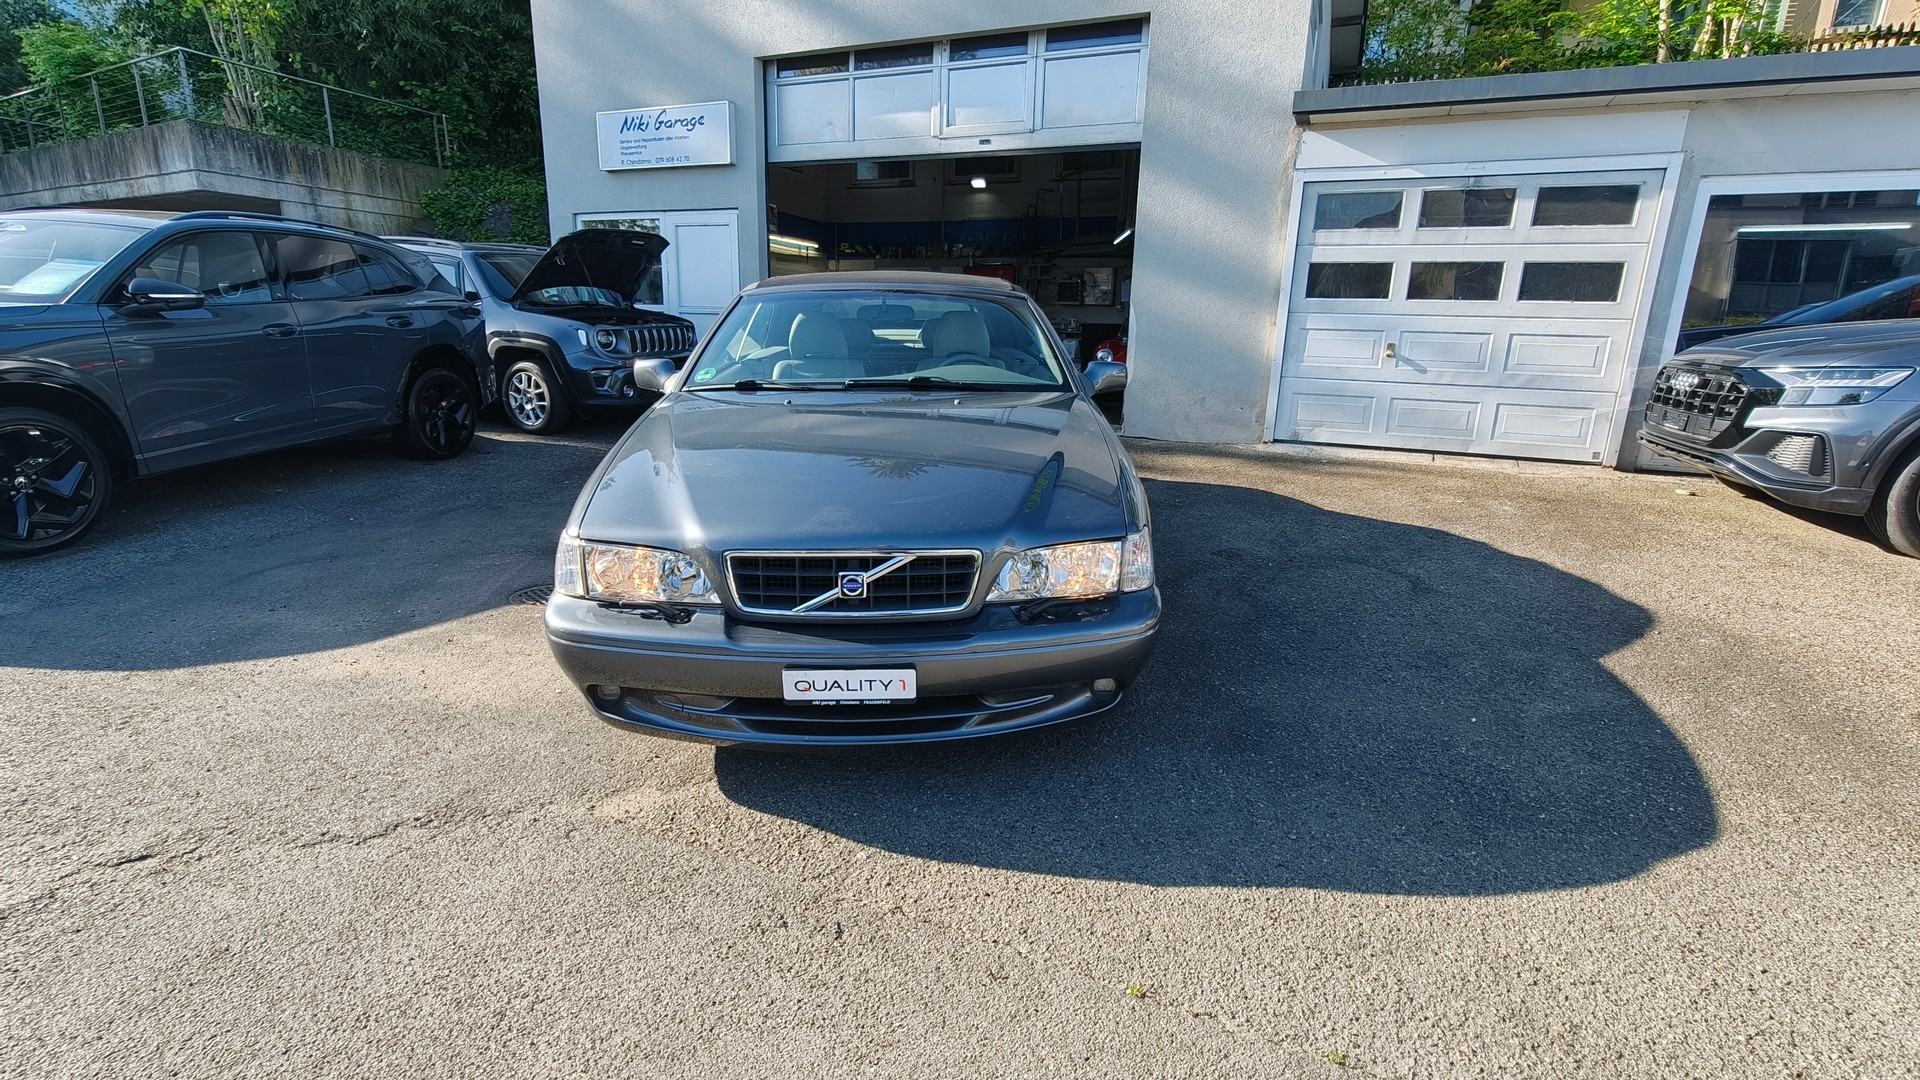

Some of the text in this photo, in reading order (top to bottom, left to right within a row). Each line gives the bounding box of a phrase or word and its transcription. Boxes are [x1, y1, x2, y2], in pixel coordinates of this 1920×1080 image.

[619, 109, 705, 134] Niki Garage
[794, 679, 907, 692] QUALITY 1
